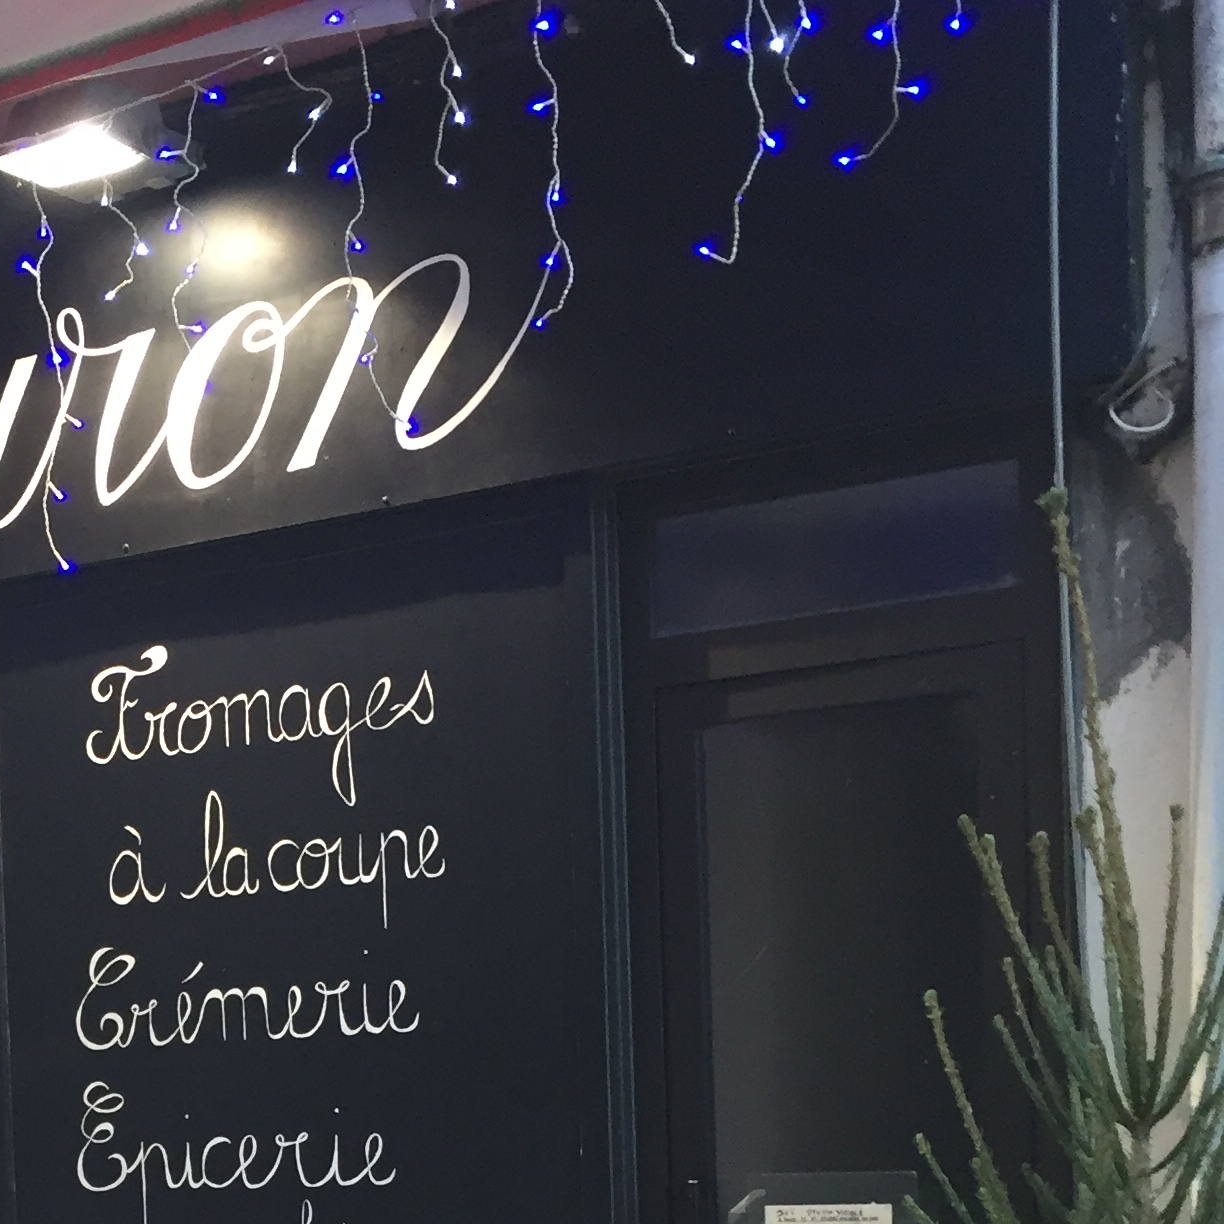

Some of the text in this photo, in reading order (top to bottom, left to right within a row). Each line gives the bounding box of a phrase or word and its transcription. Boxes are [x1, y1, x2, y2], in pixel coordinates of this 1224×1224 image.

[86, 645, 435, 806] Fromages
[109, 790, 446, 930] à la coupe
[76, 947, 420, 1051] Crémerie
